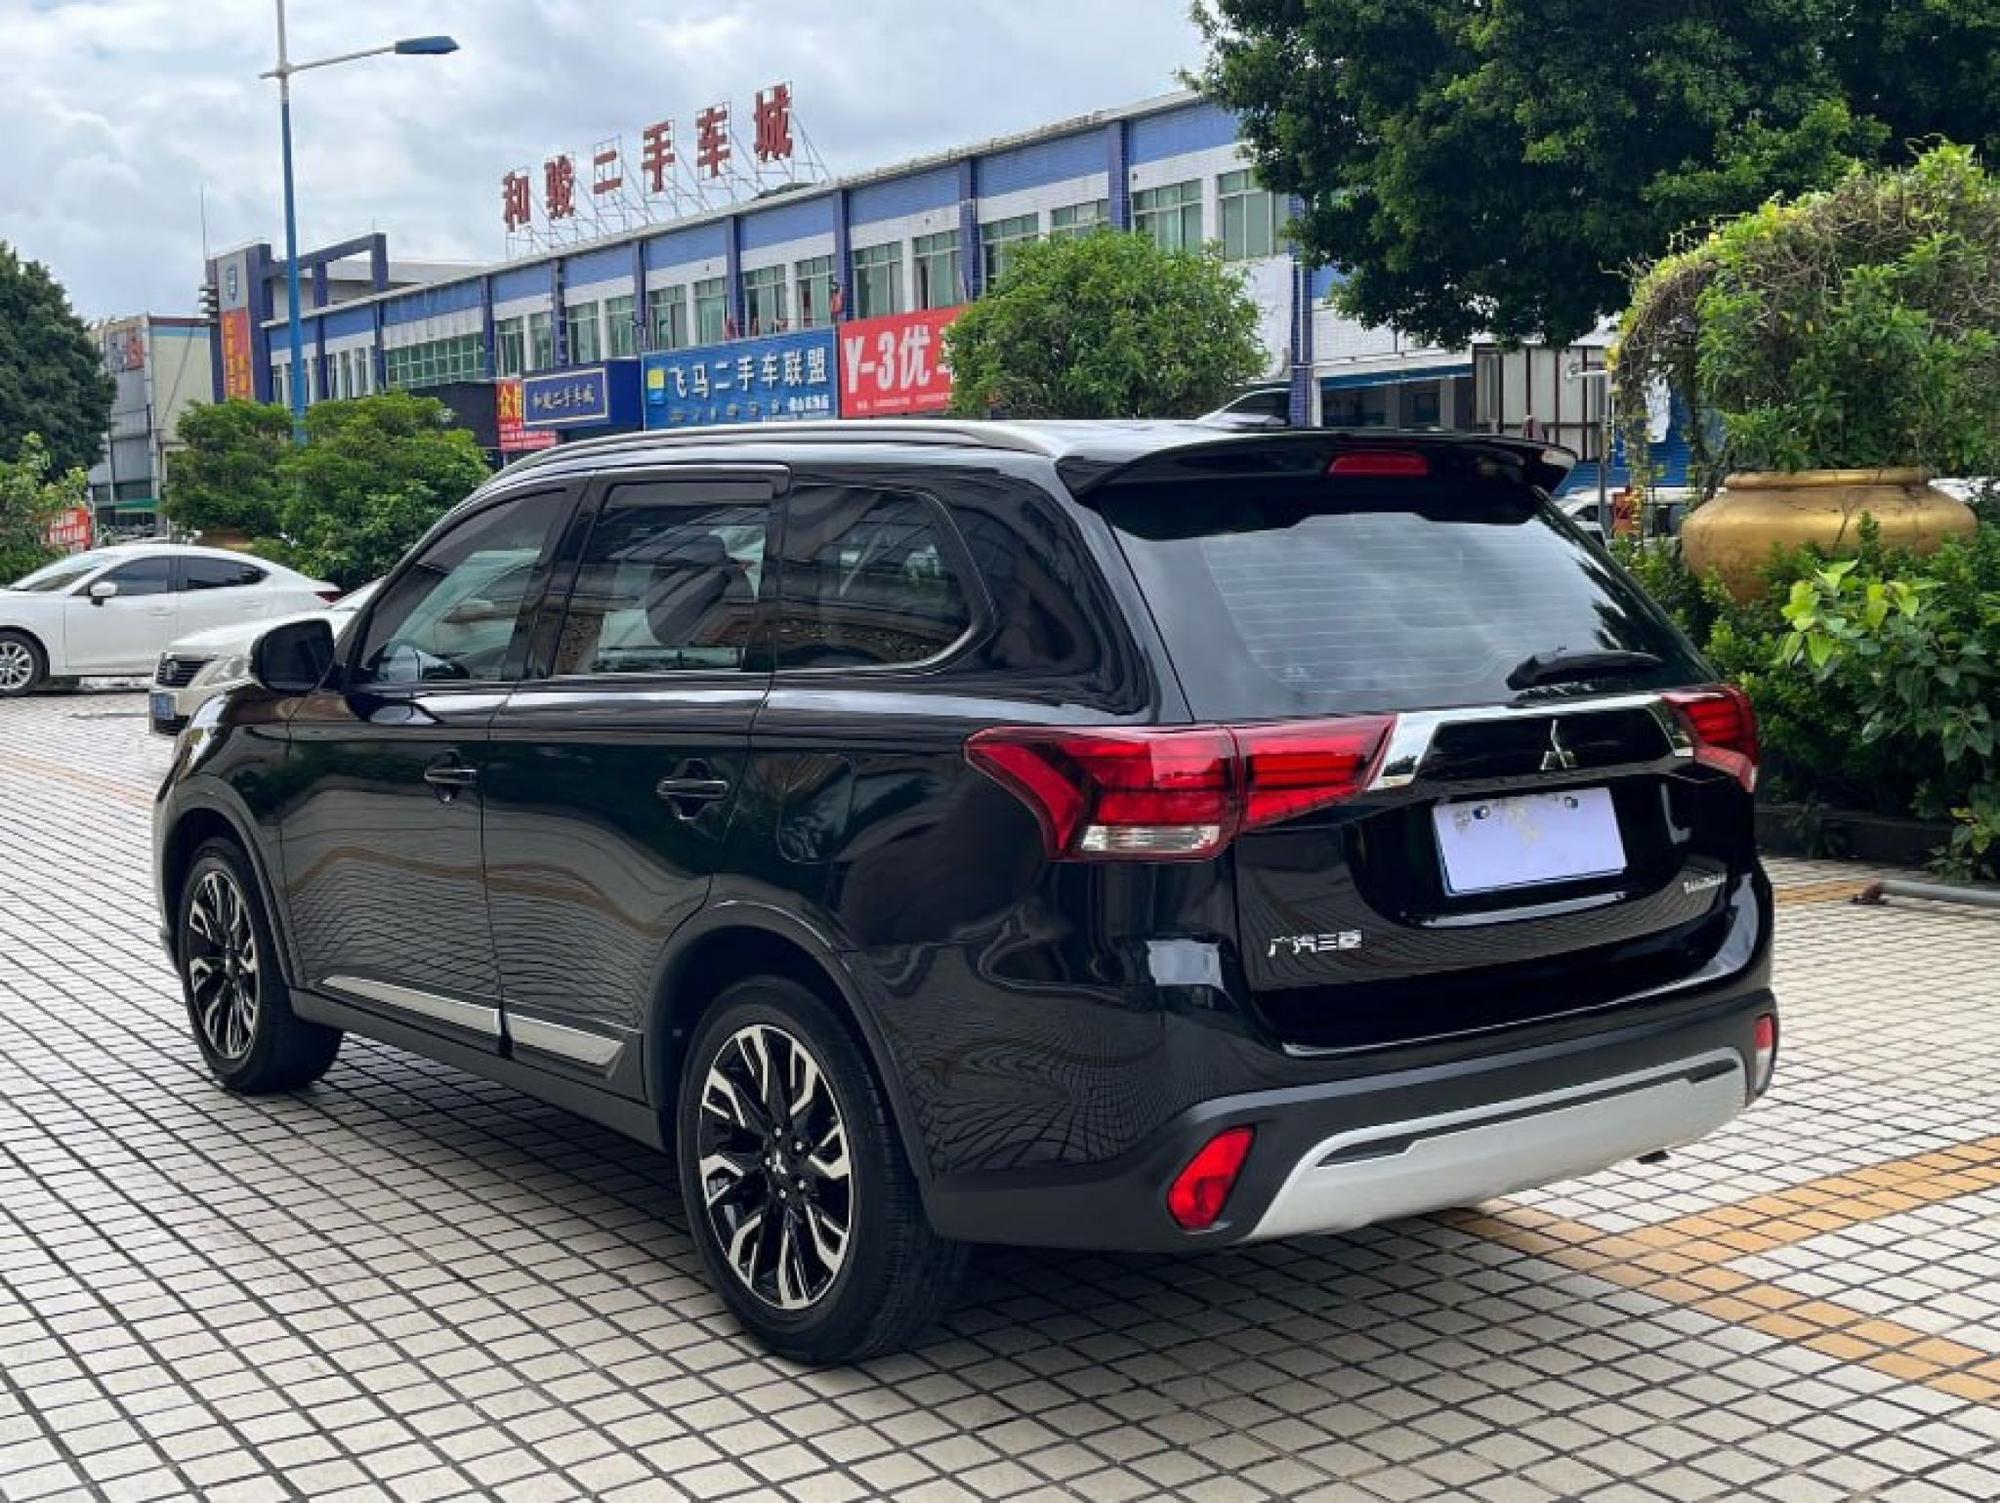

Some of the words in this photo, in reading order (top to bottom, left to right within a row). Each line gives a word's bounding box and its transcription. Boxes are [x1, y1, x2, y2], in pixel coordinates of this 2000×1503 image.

[502, 83, 793, 232] 和骏二手车城
[669, 347, 827, 398] 飞马二手车联盟
